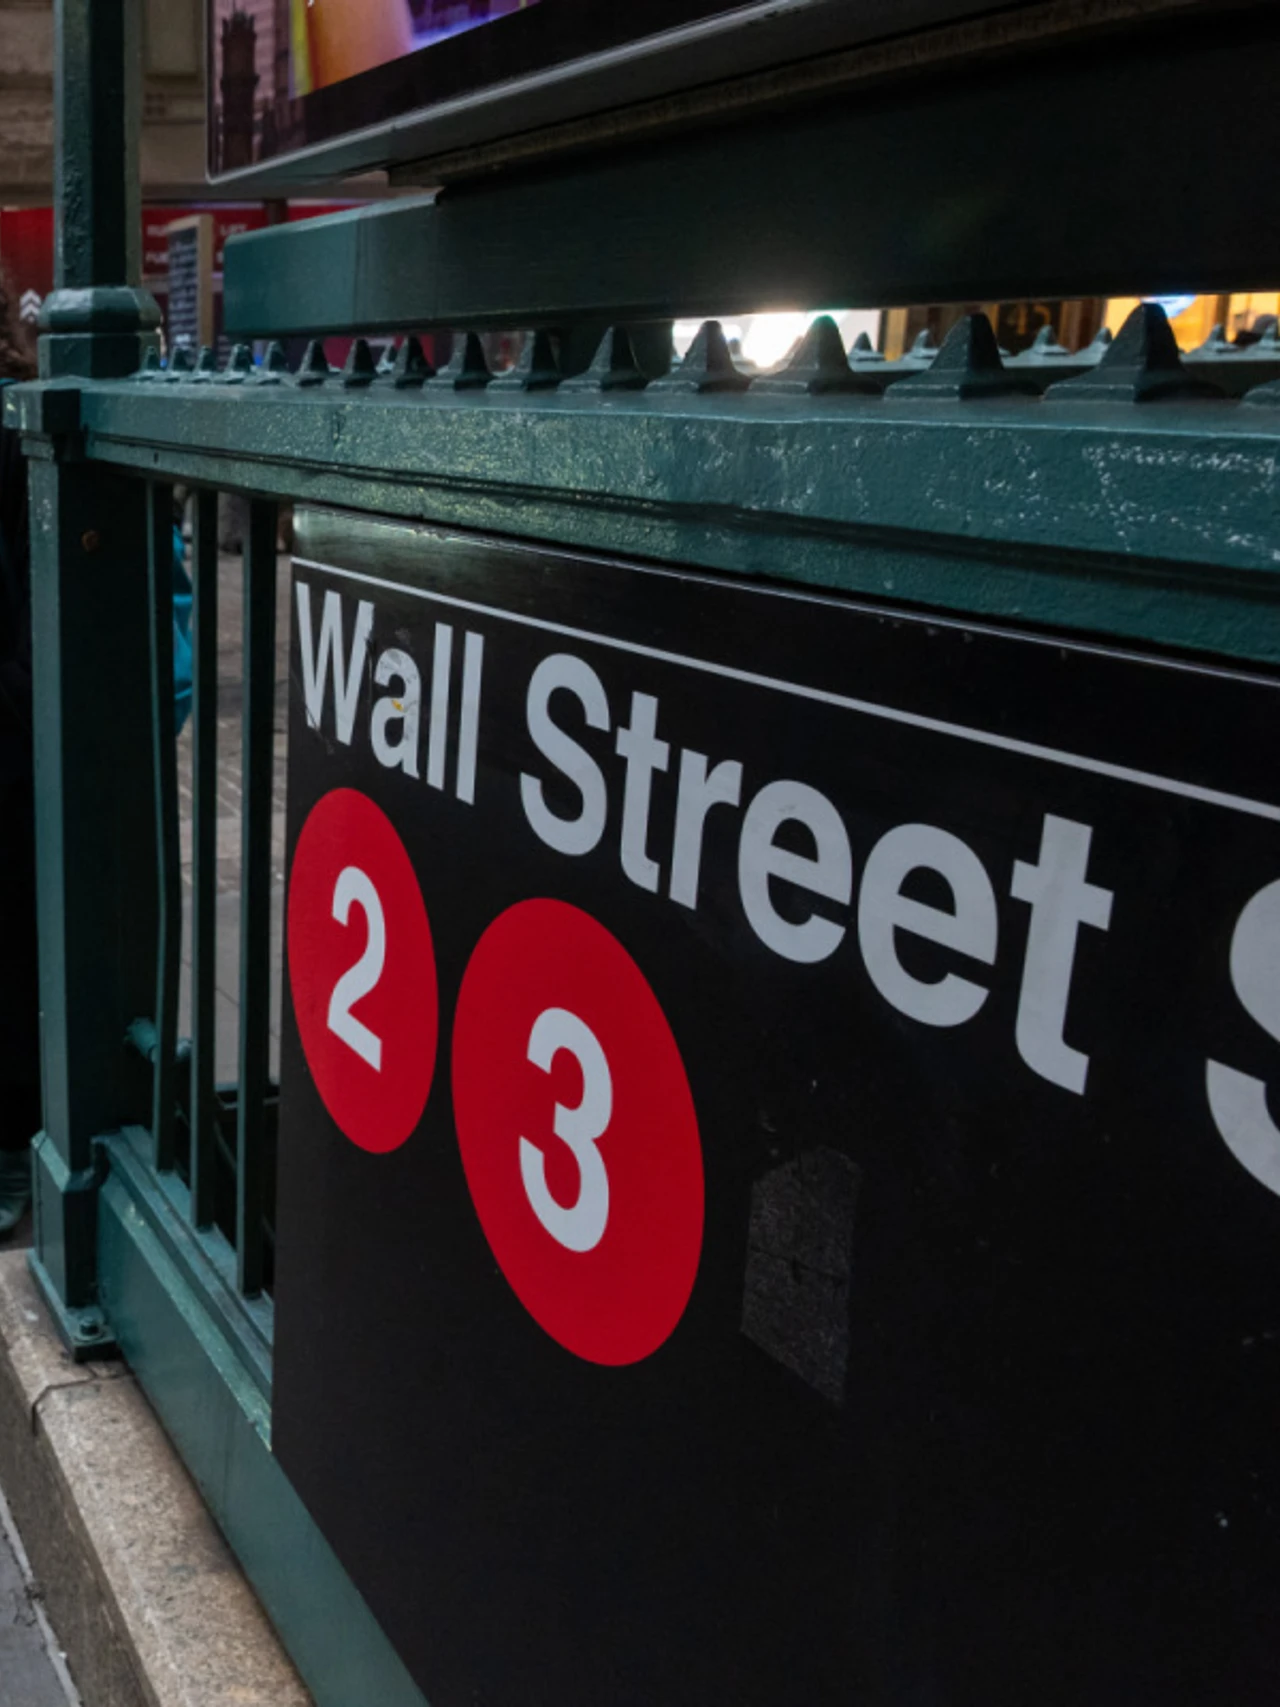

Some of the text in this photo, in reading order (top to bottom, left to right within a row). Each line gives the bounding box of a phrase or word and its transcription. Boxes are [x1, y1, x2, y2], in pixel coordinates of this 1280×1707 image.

[295, 581, 484, 805] Wall
[520, 652, 1113, 1095] Street
[326, 866, 613, 1253] 2 3
